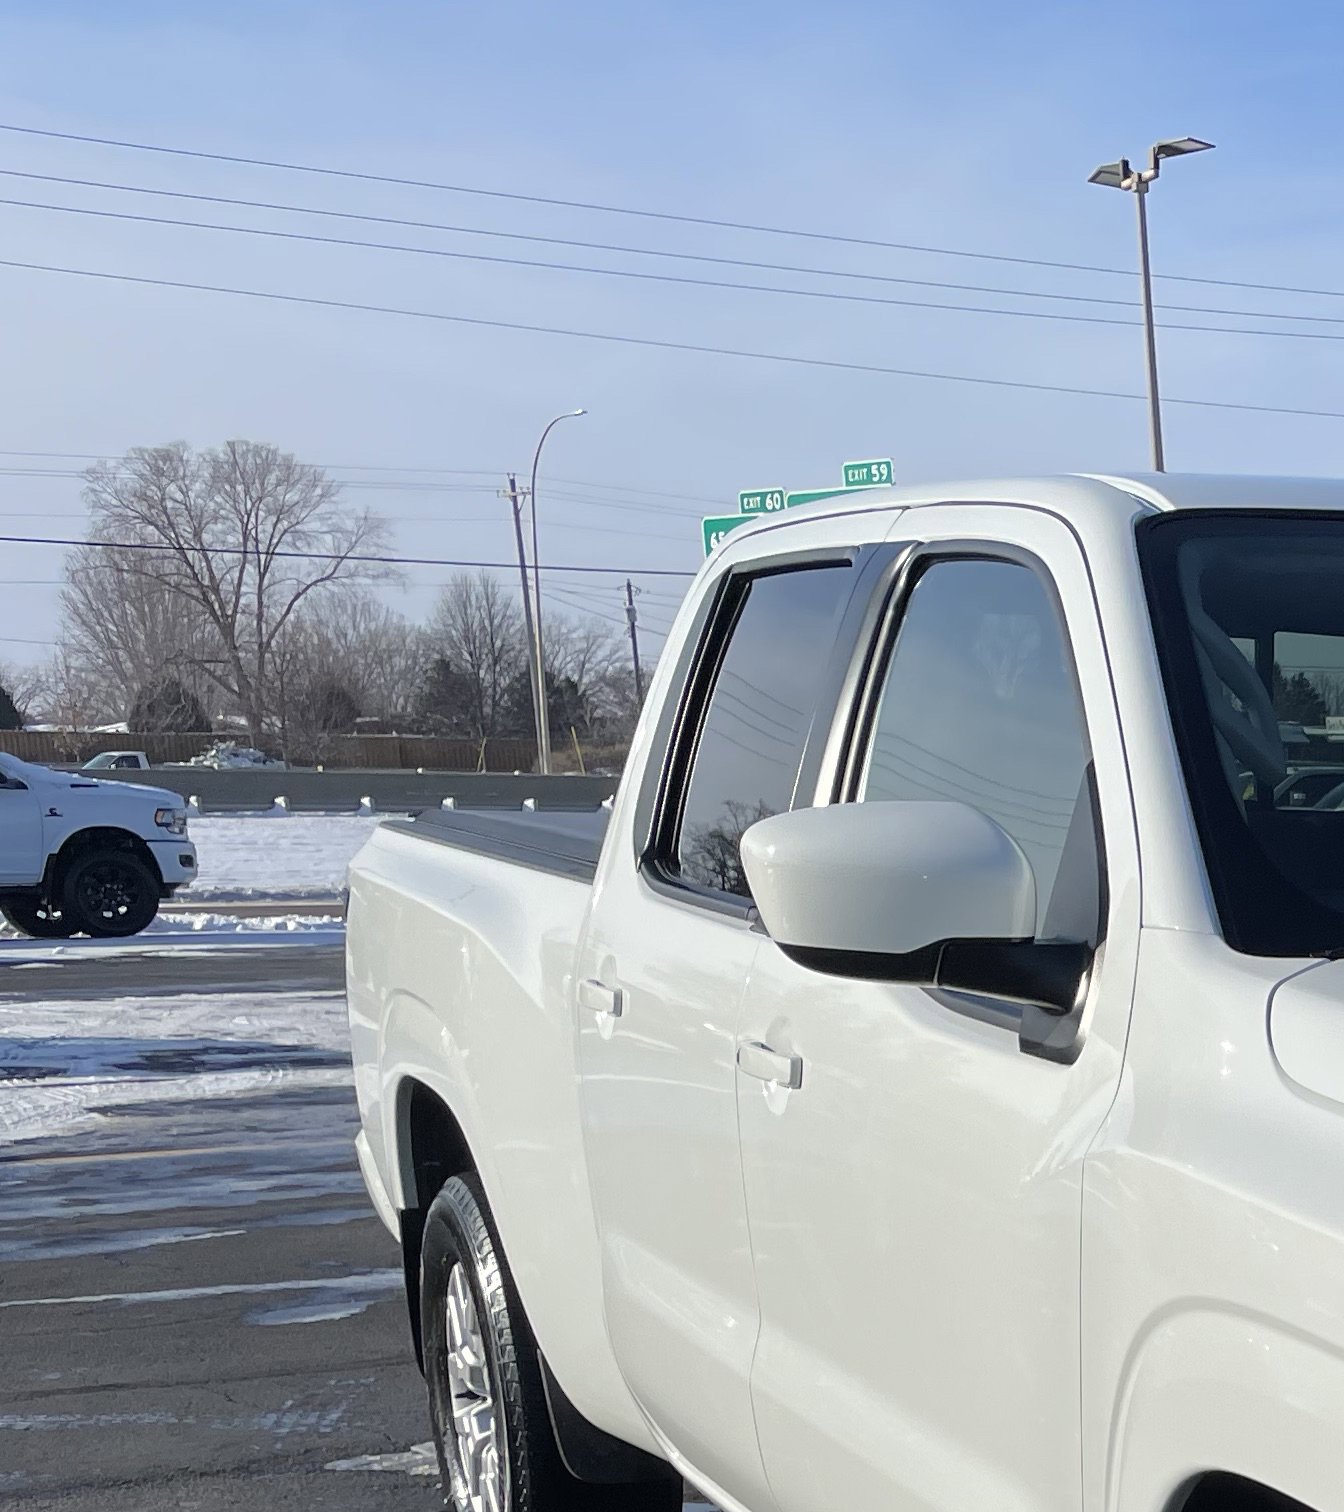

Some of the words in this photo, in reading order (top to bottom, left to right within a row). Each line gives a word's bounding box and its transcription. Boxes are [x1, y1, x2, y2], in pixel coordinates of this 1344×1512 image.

[848, 468, 868, 482] EXIT
[871, 464, 888, 482] 59
[743, 496, 761, 510] EXIT
[765, 493, 781, 511] 60
